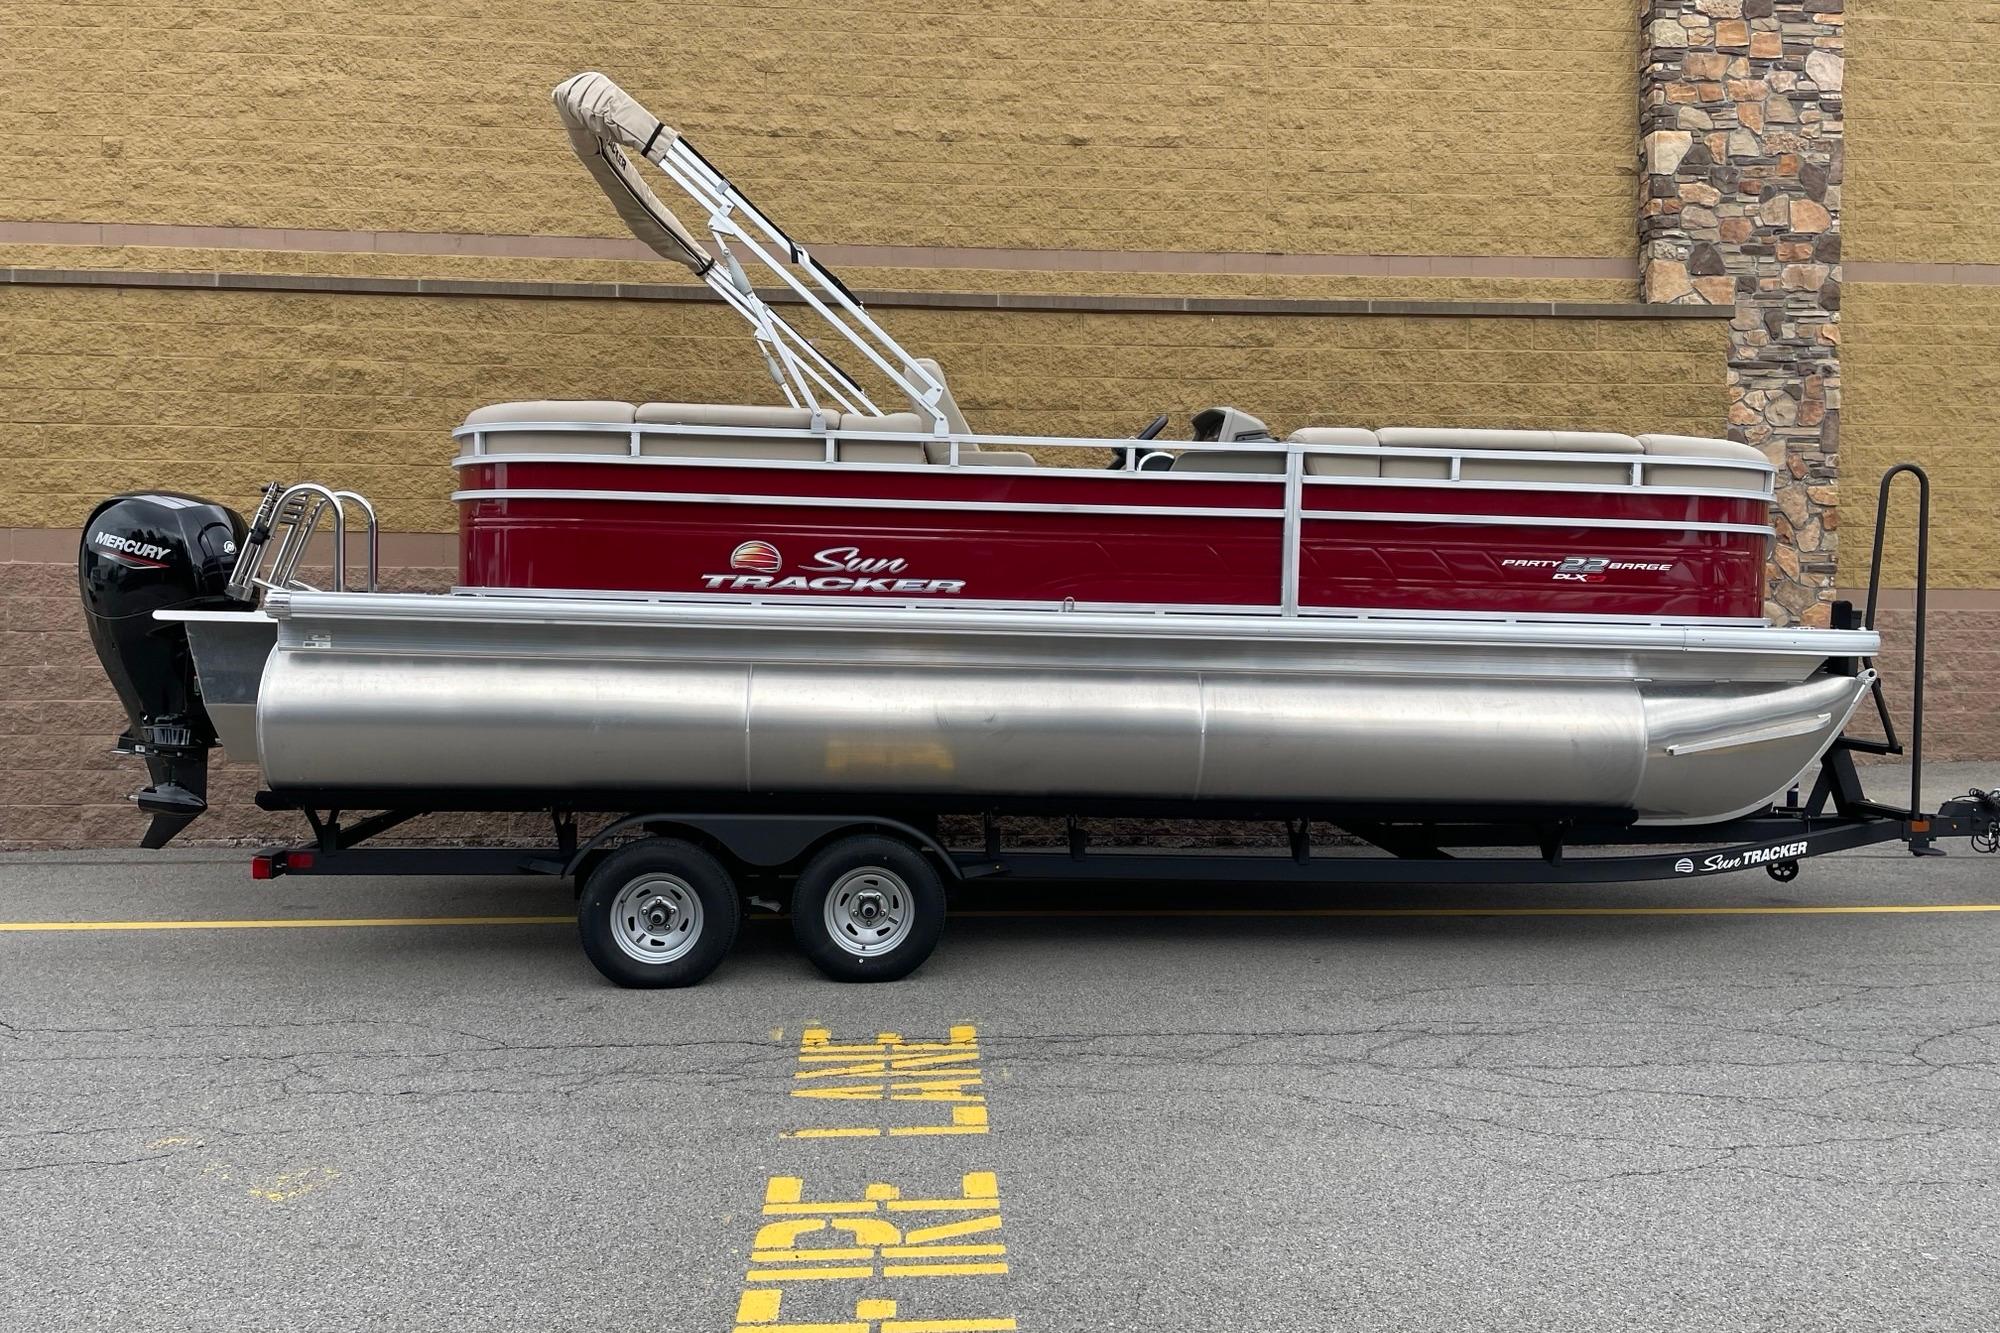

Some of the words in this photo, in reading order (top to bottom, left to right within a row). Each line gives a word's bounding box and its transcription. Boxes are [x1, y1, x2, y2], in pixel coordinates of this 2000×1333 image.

[95, 531, 171, 560] MERCURY
[798, 546, 908, 574] Sun
[1502, 559, 1561, 568] PARTY
[1556, 556, 1610, 573] 22
[1608, 562, 1672, 571] BARGE
[701, 574, 966, 594] TRACKER
[1552, 573, 1587, 582] DLX
[1700, 854, 1742, 872] Sun
[1743, 841, 1808, 865] TRACKER
